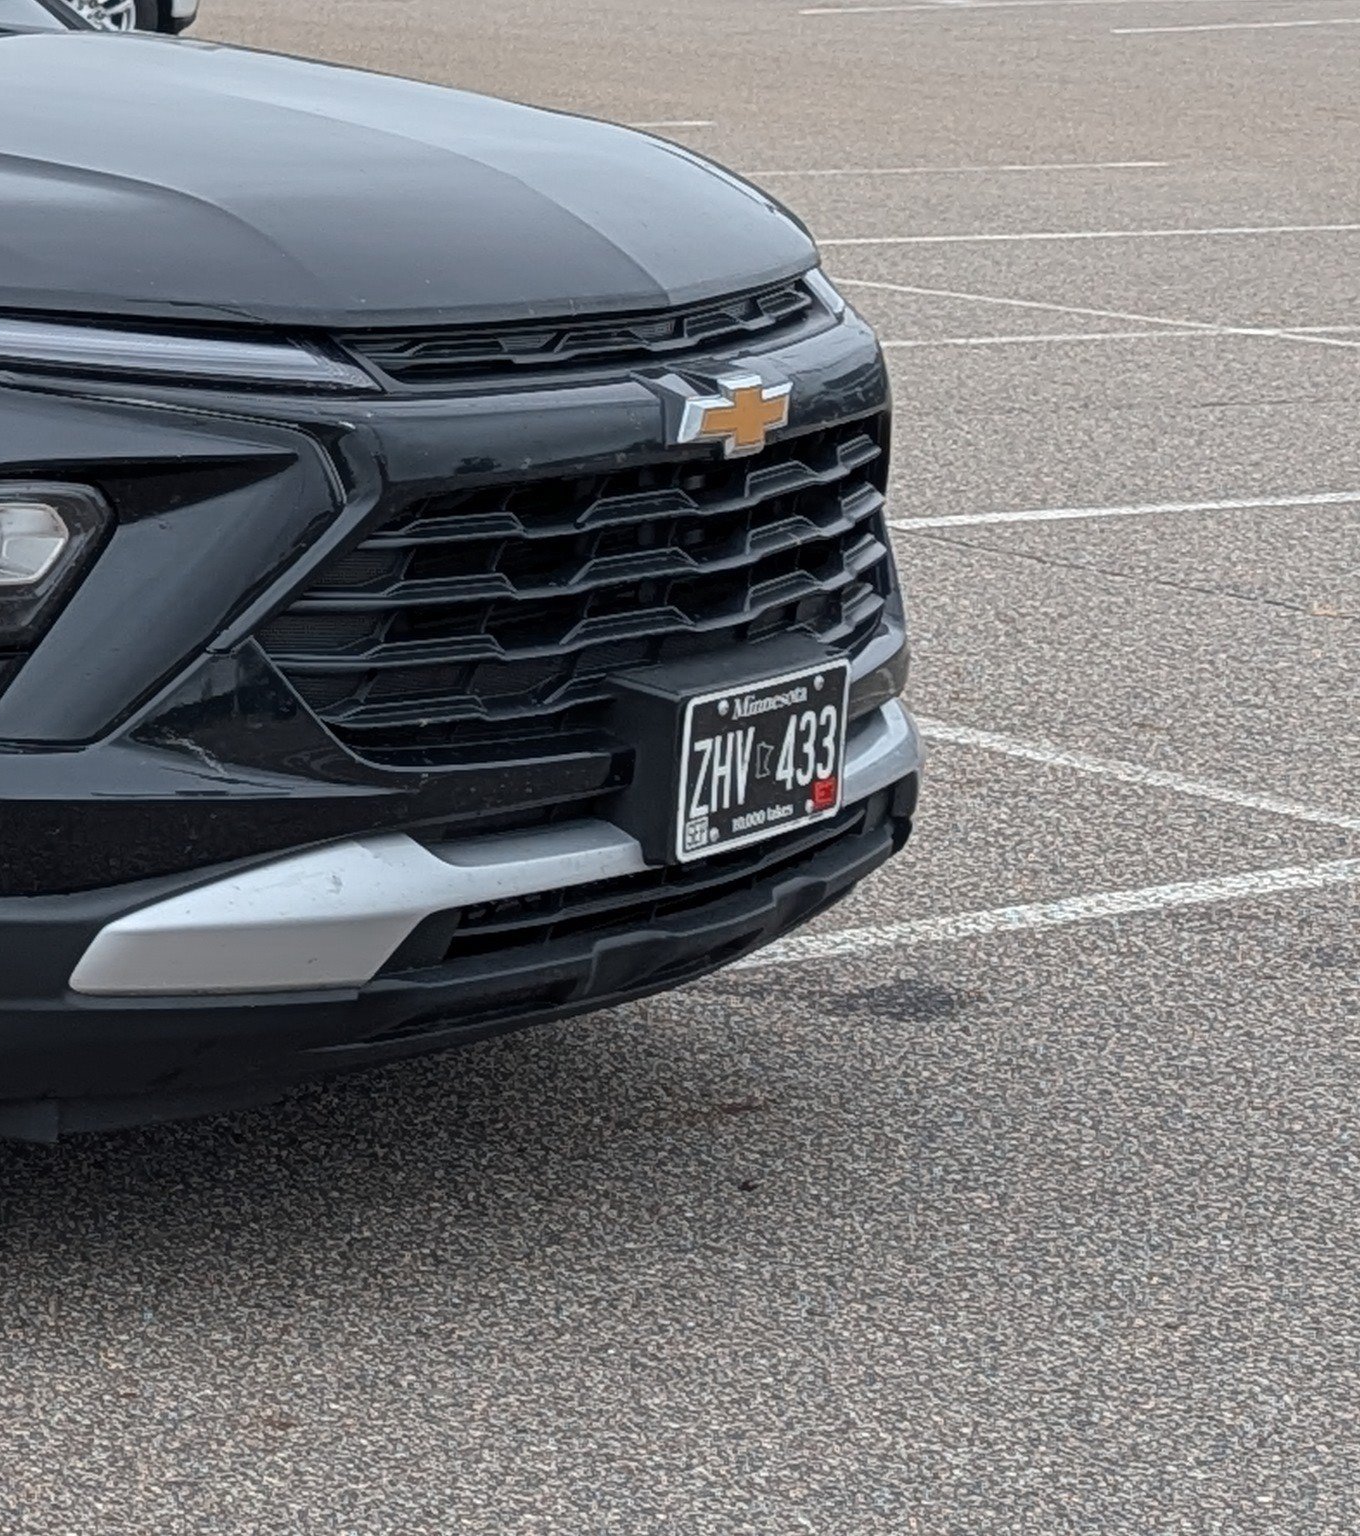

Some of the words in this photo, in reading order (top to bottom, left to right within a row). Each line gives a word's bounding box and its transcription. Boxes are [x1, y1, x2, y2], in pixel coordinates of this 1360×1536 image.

[732, 687, 808, 720] Minnesota
[690, 726, 756, 818] ZHV
[776, 704, 837, 790] 433
